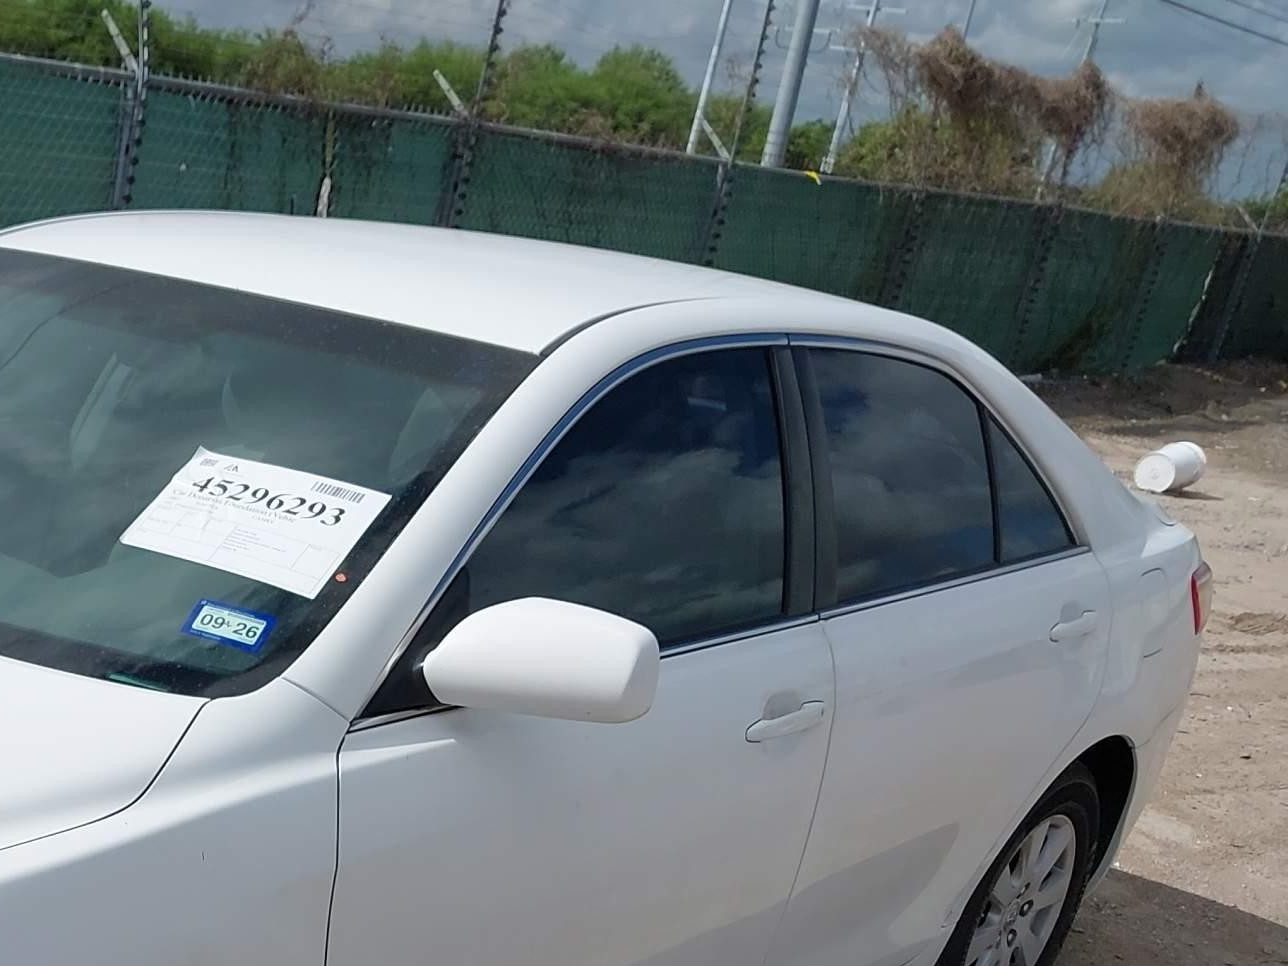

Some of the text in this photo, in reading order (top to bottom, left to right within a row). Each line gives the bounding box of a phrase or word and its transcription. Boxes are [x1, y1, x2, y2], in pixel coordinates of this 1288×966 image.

[192, 476, 347, 527] 45296293
[200, 613, 226, 629] 09
[232, 622, 260, 638] 26
